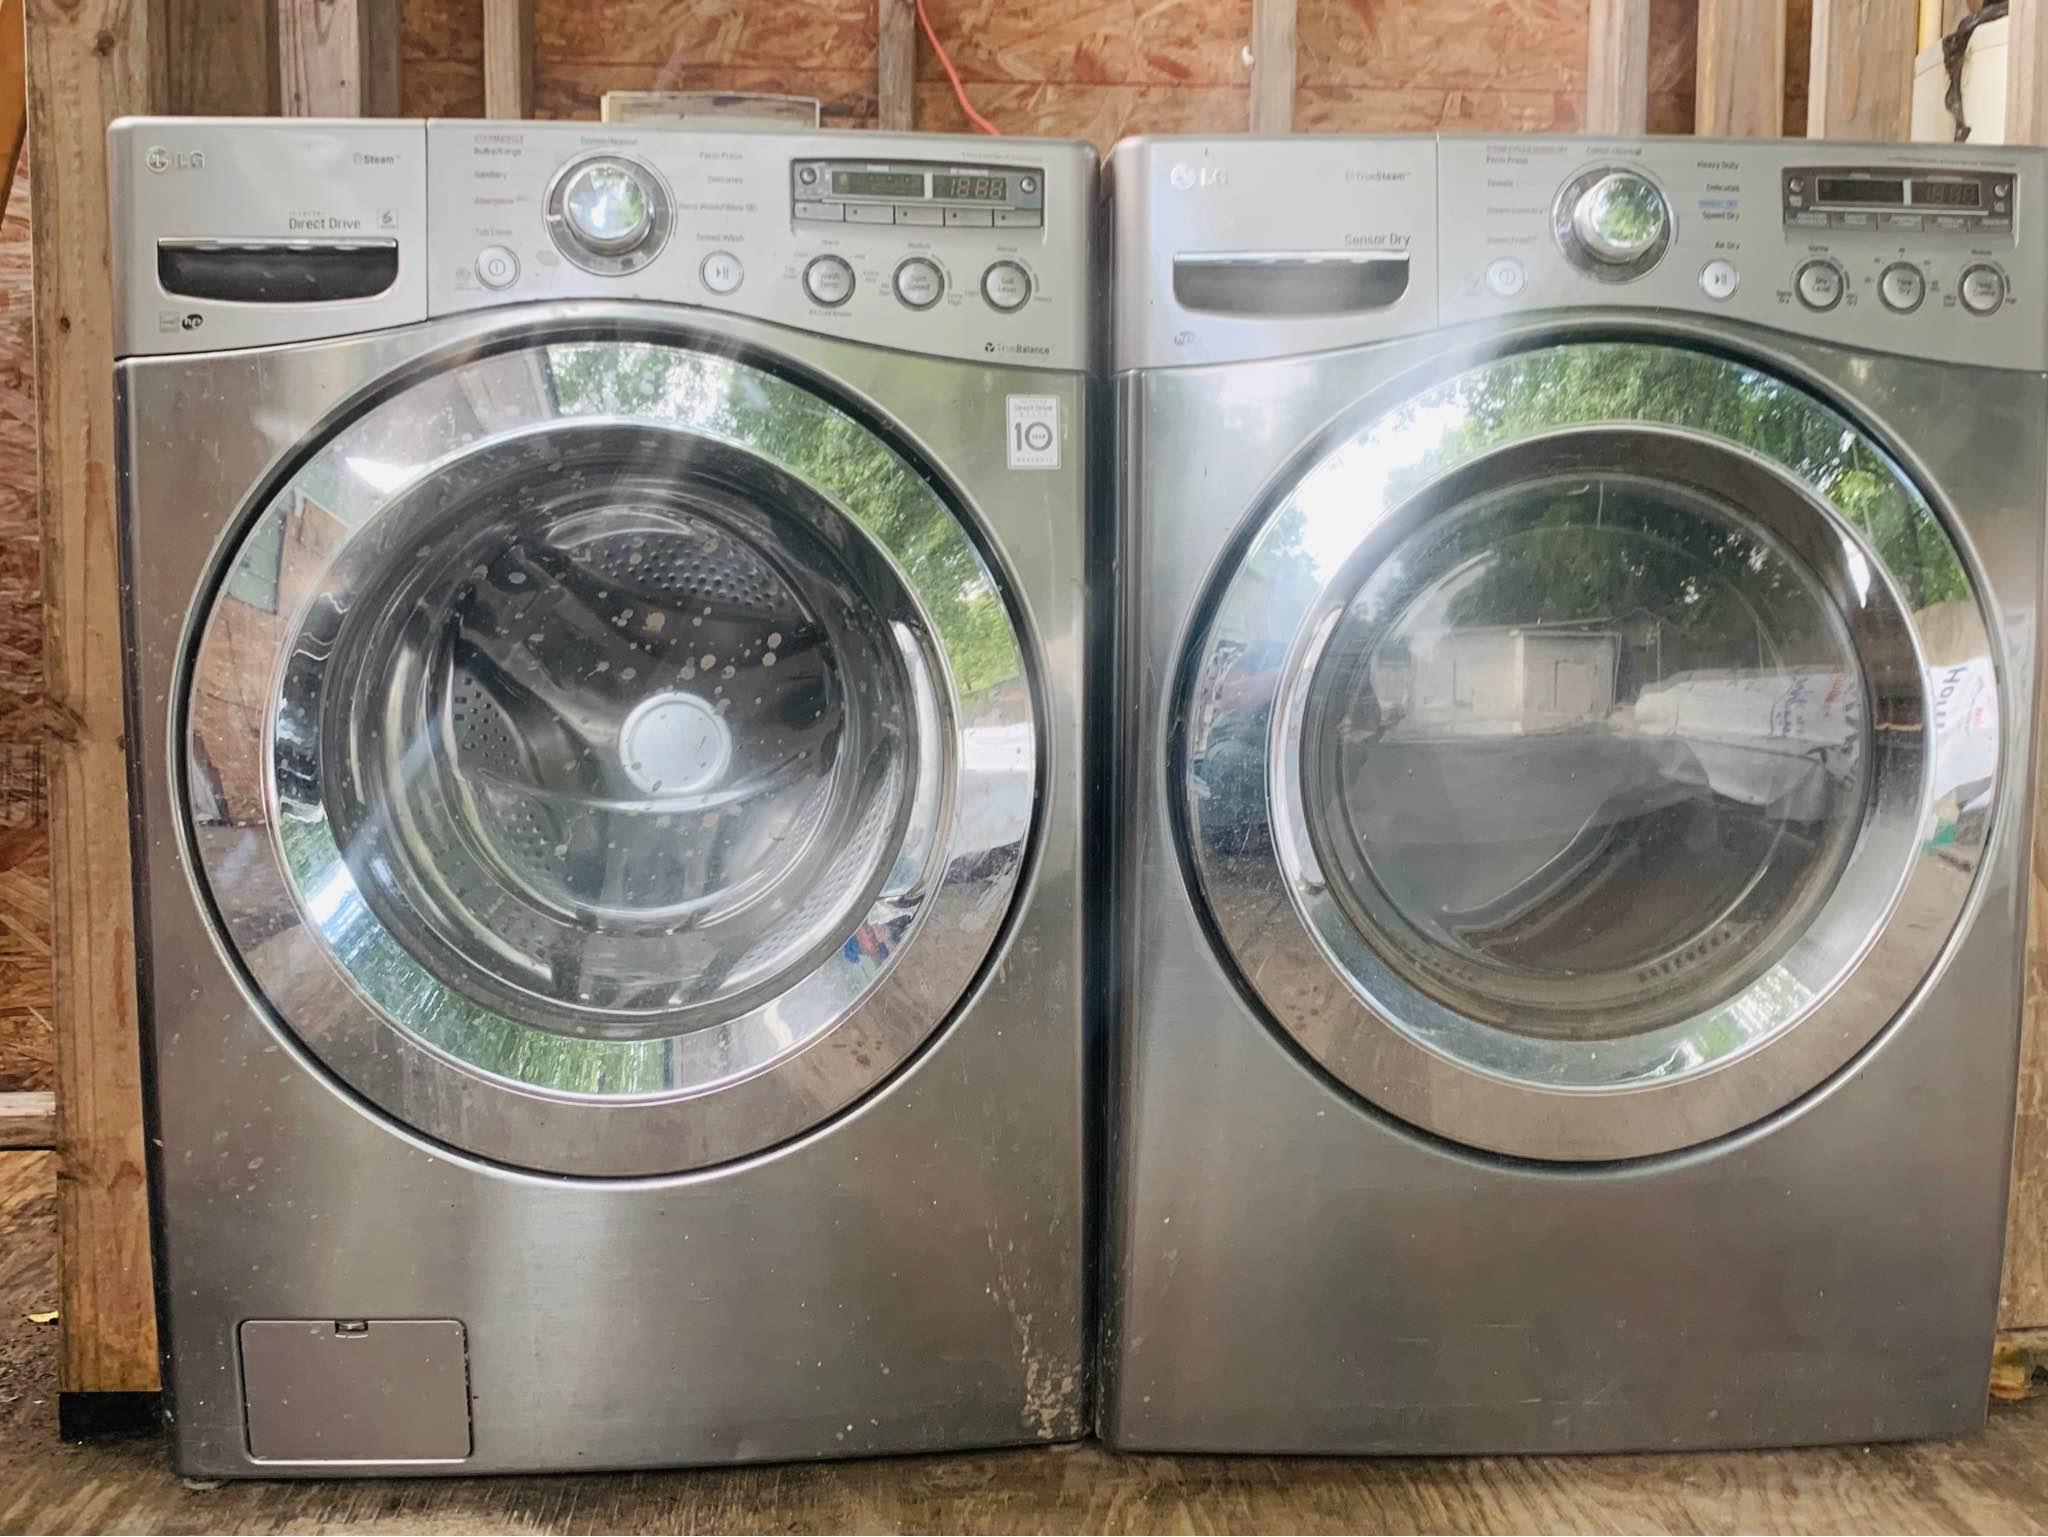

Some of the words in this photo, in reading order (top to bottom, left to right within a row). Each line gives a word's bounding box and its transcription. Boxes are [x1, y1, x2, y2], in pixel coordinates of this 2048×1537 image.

[177, 151, 206, 170] LG
[288, 217, 326, 231] Direct
[328, 217, 362, 231] Drive
[1345, 233, 1386, 247] Sensor
[1388, 233, 1411, 248] Dry
[1014, 421, 1054, 452] 10
